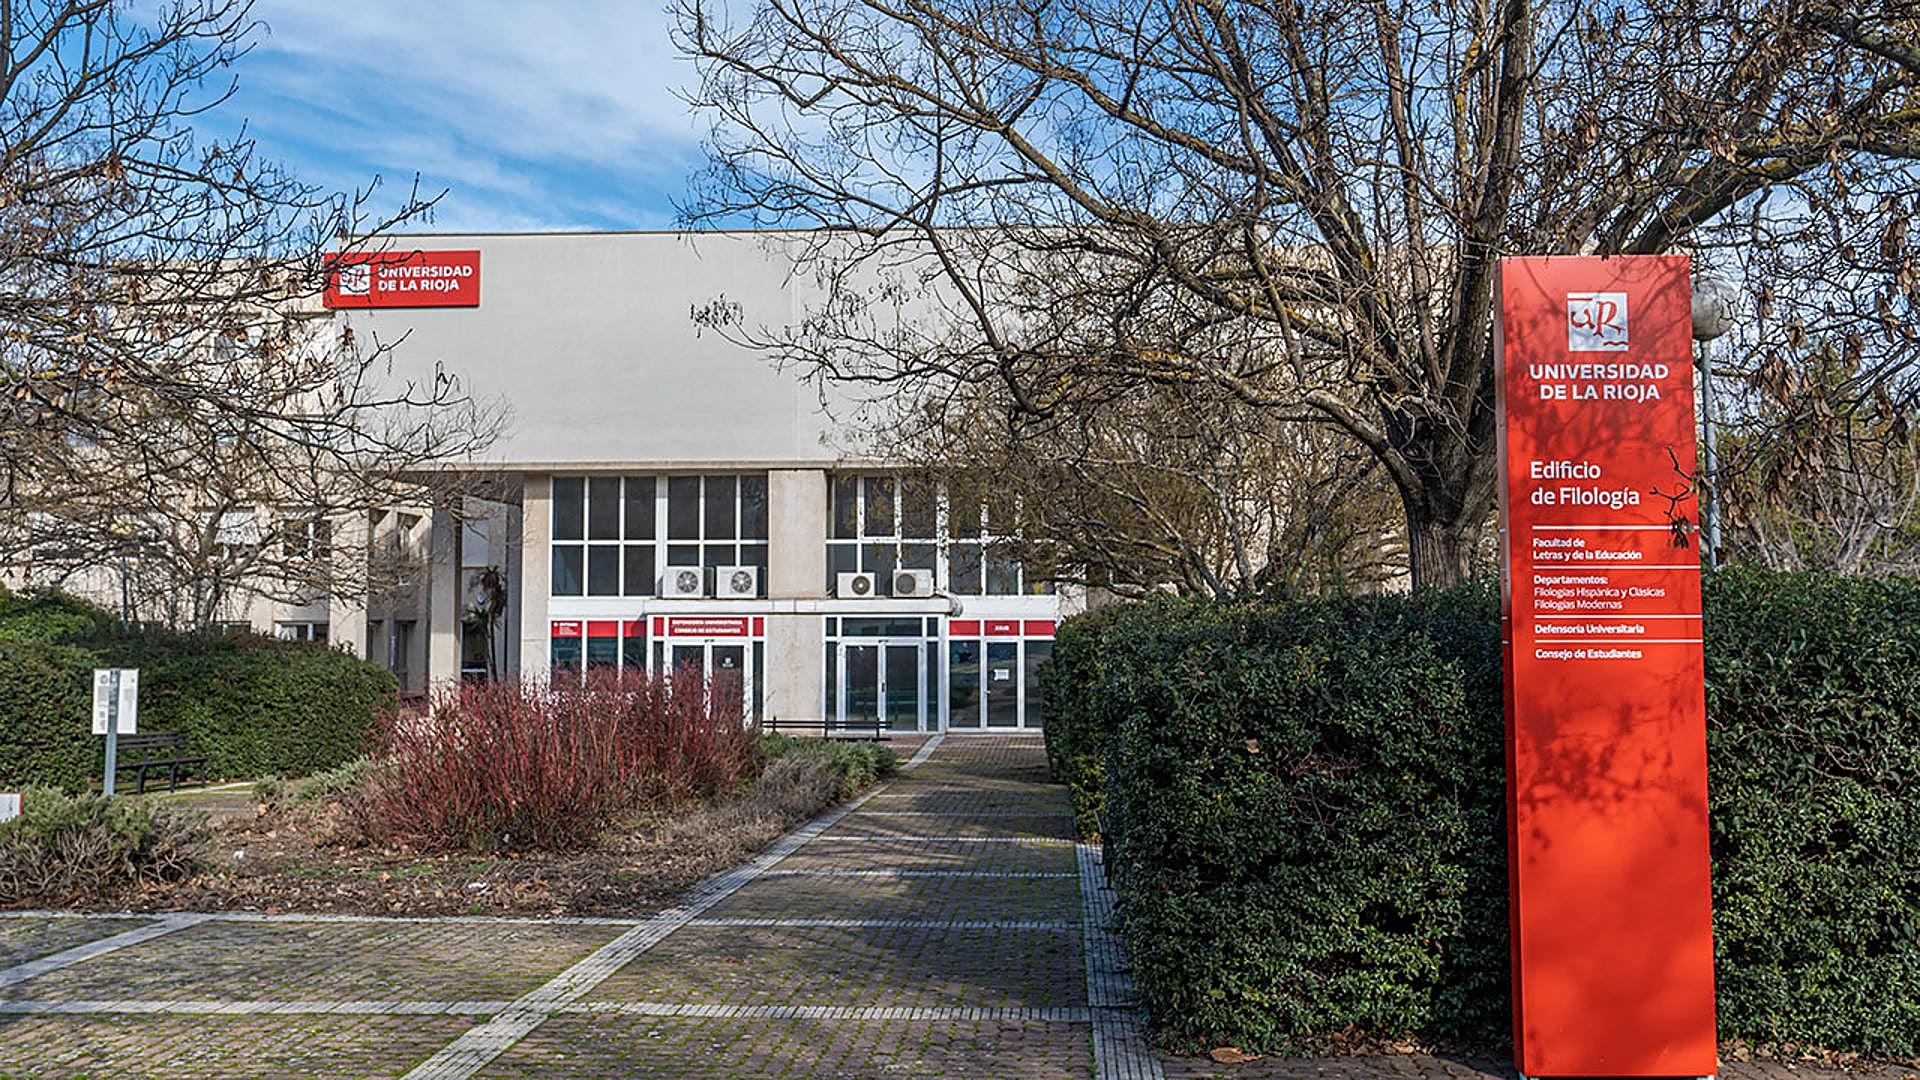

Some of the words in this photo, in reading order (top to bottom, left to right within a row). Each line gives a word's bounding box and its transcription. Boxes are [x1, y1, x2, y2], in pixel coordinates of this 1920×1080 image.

[378, 266, 473, 278] UNIVERSIDAD
[378, 280, 397, 291] DE
[400, 280, 418, 291] LA
[421, 280, 460, 292] RIOJA
[1529, 363, 1669, 380] UNIVERSIDAD
[1540, 384, 1567, 400] DE
[1572, 384, 1599, 400] LA
[1603, 384, 1661, 403] RIOJA
[1530, 460, 1601, 479] Edificio
[1531, 487, 1559, 505] de
[1560, 486, 1640, 509] Filología
[1533, 538, 1571, 548] Facultad
[1572, 538, 1585, 548] de
[1533, 550, 1563, 560] Letras
[1564, 552, 1571, 562] y
[1572, 550, 1584, 560] de
[1585, 550, 1594, 560] la
[1595, 550, 1642, 560] Educación
[1533, 575, 1608, 586] Departamentos:
[1534, 587, 1575, 599] Filologías
[1576, 587, 1620, 599] Hispánica
[1621, 589, 1627, 599] y
[1629, 587, 1665, 597] Clásicas
[1577, 600, 1623, 609] Modernas
[1586, 624, 1645, 634] Universitaria
[1535, 649, 1573, 660] Consejo
[1574, 649, 1586, 659] de
[1587, 649, 1642, 659] Estudiantes
